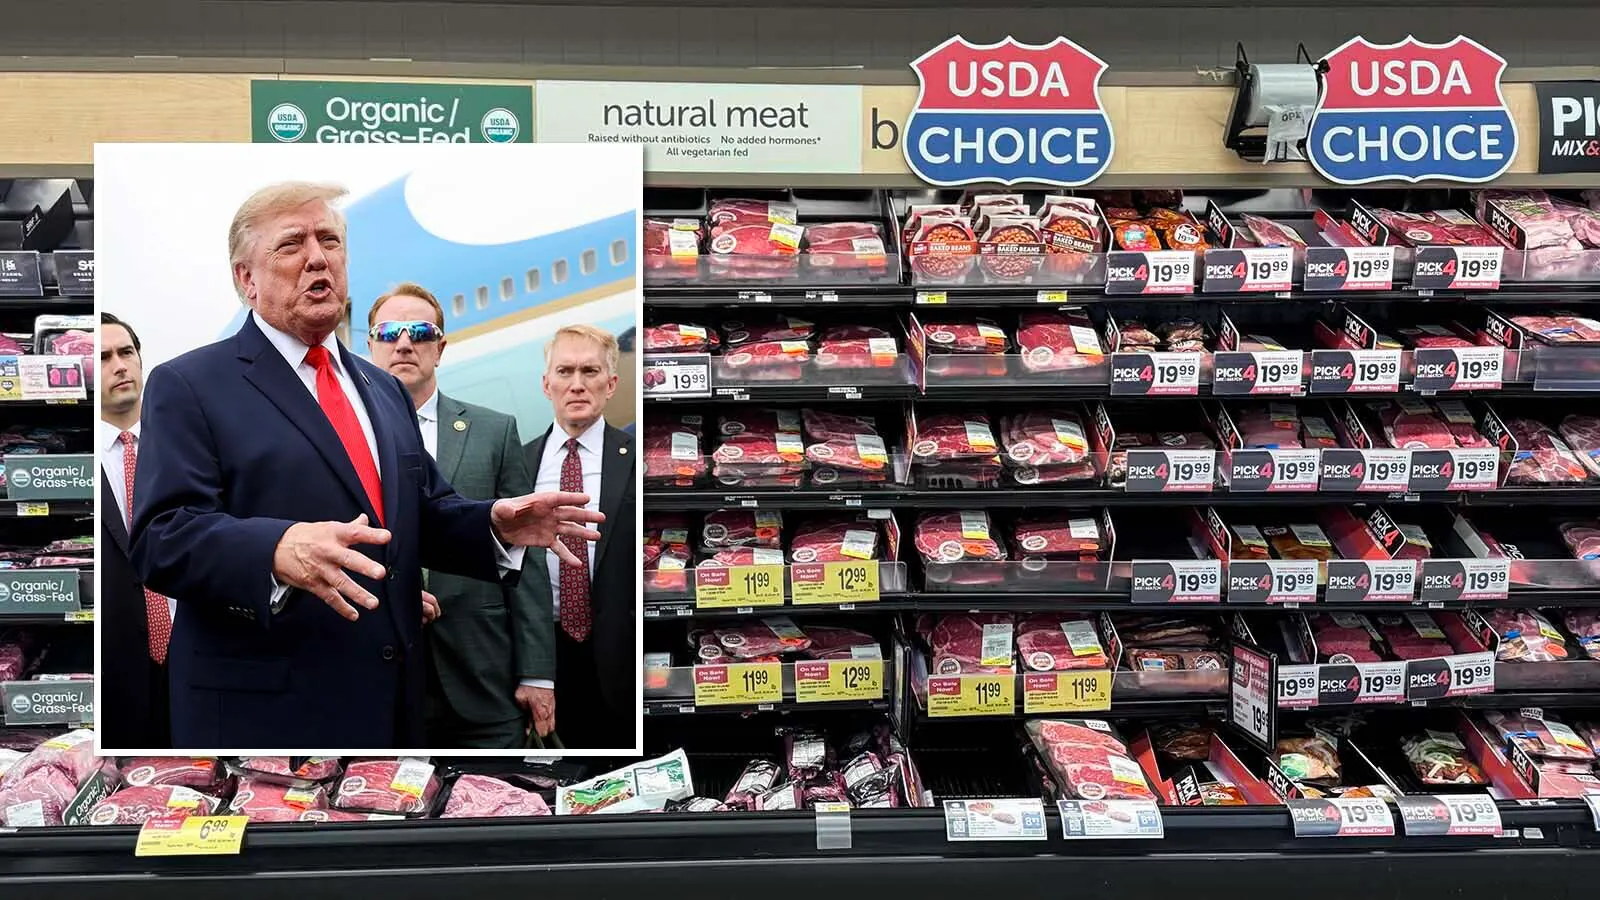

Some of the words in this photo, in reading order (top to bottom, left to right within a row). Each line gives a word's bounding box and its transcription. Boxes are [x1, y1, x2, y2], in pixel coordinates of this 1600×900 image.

[949, 61, 1070, 97] USDA
[1351, 60, 1472, 96] USDA
[278, 114, 298, 122] USDA
[490, 118, 510, 126] USDA
[603, 99, 716, 128] natural
[726, 102, 809, 128] meat
[1552, 97, 1600, 136] PI
[316, 125, 470, 143] Grass-Fed
[588, 134, 619, 143] Raised
[622, 134, 659, 144] without
[661, 135, 711, 144] antibiotics
[721, 136, 733, 144] No
[737, 136, 766, 145] added
[918, 127, 1099, 165] CHOICE
[1323, 125, 1503, 163] CHOICE
[667, 148, 678, 156] All
[681, 148, 731, 158] vegetarian
[734, 148, 749, 156] fed
[1352, 208, 1370, 232] PICK
[1368, 223, 1378, 244] 4
[1073, 239, 1094, 250] BEANS
[1108, 267, 1134, 277] PICK
[1135, 264, 1147, 280] 4
[1207, 265, 1233, 274] PICK
[1233, 262, 1246, 278] 4
[1307, 263, 1335, 273] PICK
[1334, 260, 1348, 277] 4
[1416, 262, 1443, 272] PICK
[1443, 259, 1457, 276] 4
[1346, 315, 1362, 337] PICK
[1359, 328, 1368, 347] 4
[1486, 315, 1504, 335] PICK
[1503, 328, 1512, 347] 4
[1113, 369, 1140, 377] PICK
[1140, 366, 1153, 381] 4
[1216, 368, 1243, 377] PICK
[1243, 365, 1256, 381] 4
[1314, 366, 1341, 376] PICK
[1341, 364, 1354, 379] 4
[1417, 365, 1444, 374] PICK
[1444, 361, 1457, 378] 4
[1483, 411, 1502, 437] PICK
[1498, 433, 1509, 452] 4
[1128, 465, 1155, 476] PICK
[1155, 463, 1168, 479] 4
[1233, 465, 1260, 476] PICK
[1260, 463, 1273, 479] 4
[1324, 465, 1351, 475] PICK
[1351, 462, 1363, 478] 4
[1412, 464, 1439, 475] PICK
[1439, 462, 1452, 478] 4
[33, 477, 94, 488] Grass-Fed
[1371, 509, 1391, 535] PICK
[1384, 529, 1399, 547] 4
[744, 572, 770, 595] 1199
[838, 567, 867, 590] 1299
[1134, 577, 1161, 586] PICK
[1161, 575, 1174, 590] 4
[1231, 577, 1257, 586] PICK
[1258, 575, 1272, 590] 4
[1329, 576, 1356, 586] PICK
[1356, 574, 1369, 590] 4
[1424, 575, 1451, 585] PICK
[1450, 573, 1464, 588] 4
[12, 591, 73, 602] Grass-Fed
[743, 670, 768, 693] 1199
[842, 666, 871, 688] 1299
[1320, 680, 1347, 690] PICK
[1347, 675, 1360, 692] 4
[1410, 674, 1436, 684] PICK
[1436, 670, 1449, 685] 4
[975, 682, 1001, 705] 1199
[1071, 678, 1097, 700] 1199
[32, 703, 93, 714] Grass-Fed
[1513, 747, 1528, 769] PICK
[1181, 776, 1198, 801] PICK
[1268, 766, 1289, 791] PICK
[1287, 787, 1297, 799] 4
[1295, 807, 1324, 817] PICK
[1325, 805, 1340, 821] 4
[1405, 806, 1433, 816] PICK
[1433, 805, 1449, 821] 4
[200, 820, 228, 840] 699
